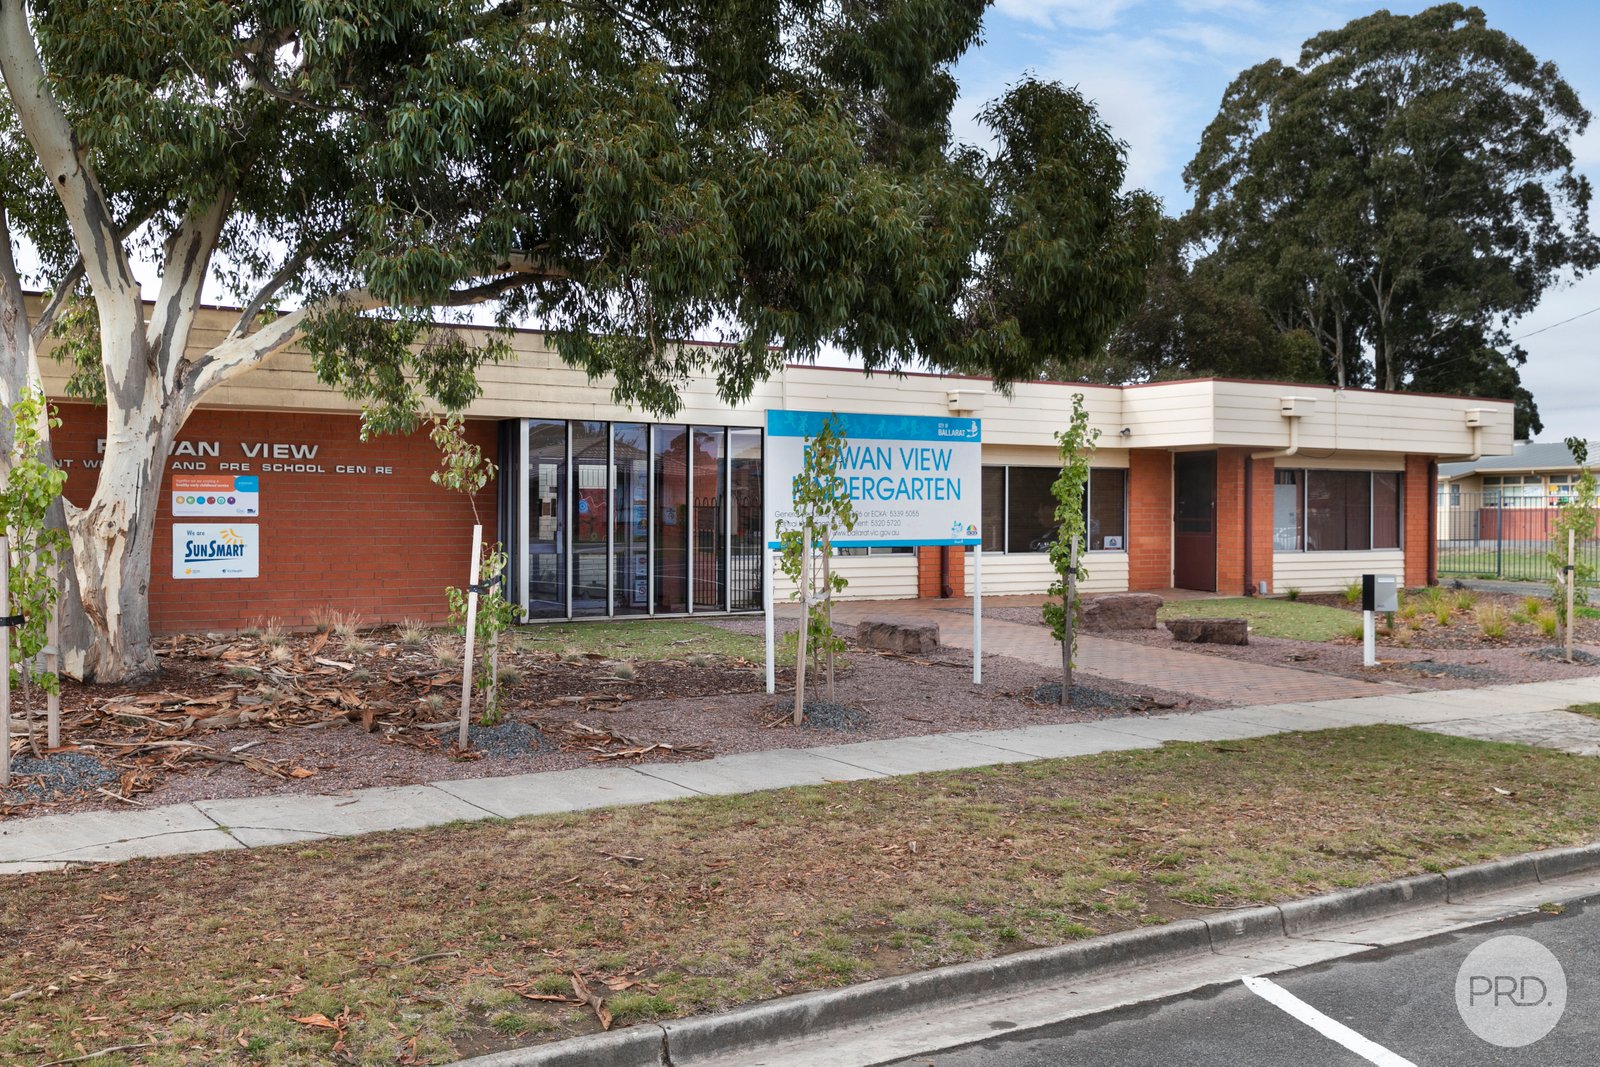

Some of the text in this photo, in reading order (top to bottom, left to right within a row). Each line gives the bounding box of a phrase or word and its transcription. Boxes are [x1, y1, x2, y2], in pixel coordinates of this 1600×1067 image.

[937, 428, 965, 436] BALLARAT
[241, 442, 319, 460] VIEW
[899, 447, 953, 471] VIEW
[171, 461, 207, 470] AND
[219, 462, 250, 472] PRE
[262, 463, 325, 473] SCHOOL
